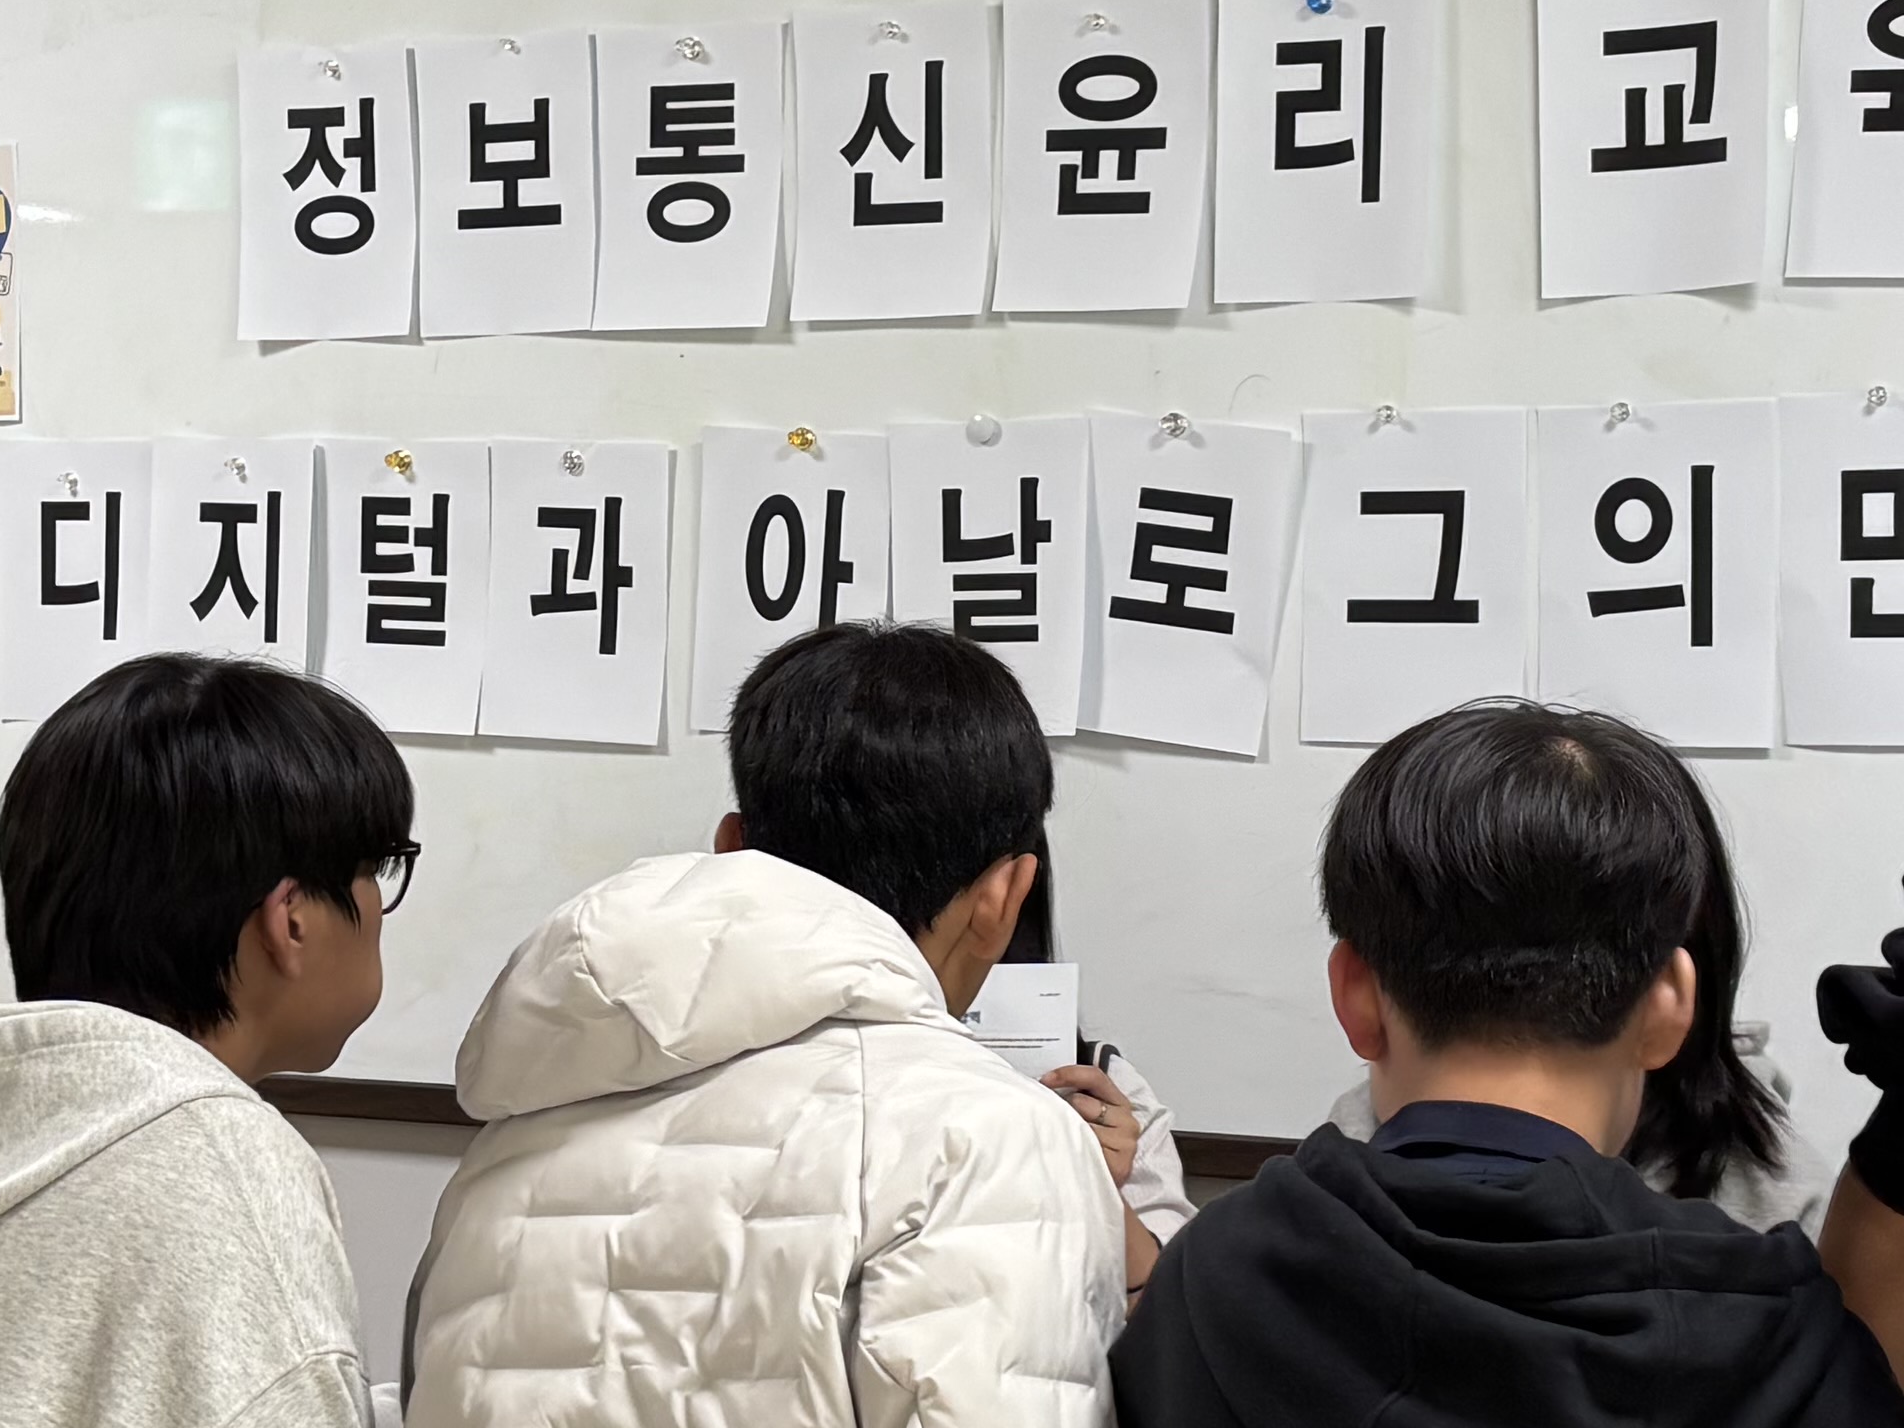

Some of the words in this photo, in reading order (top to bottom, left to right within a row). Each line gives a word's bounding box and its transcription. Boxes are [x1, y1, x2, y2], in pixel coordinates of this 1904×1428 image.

[282, 26, 1385, 256] 정보통신윤리
[40, 491, 634, 655] 디지털과
[745, 463, 1715, 647] 아날로그의
